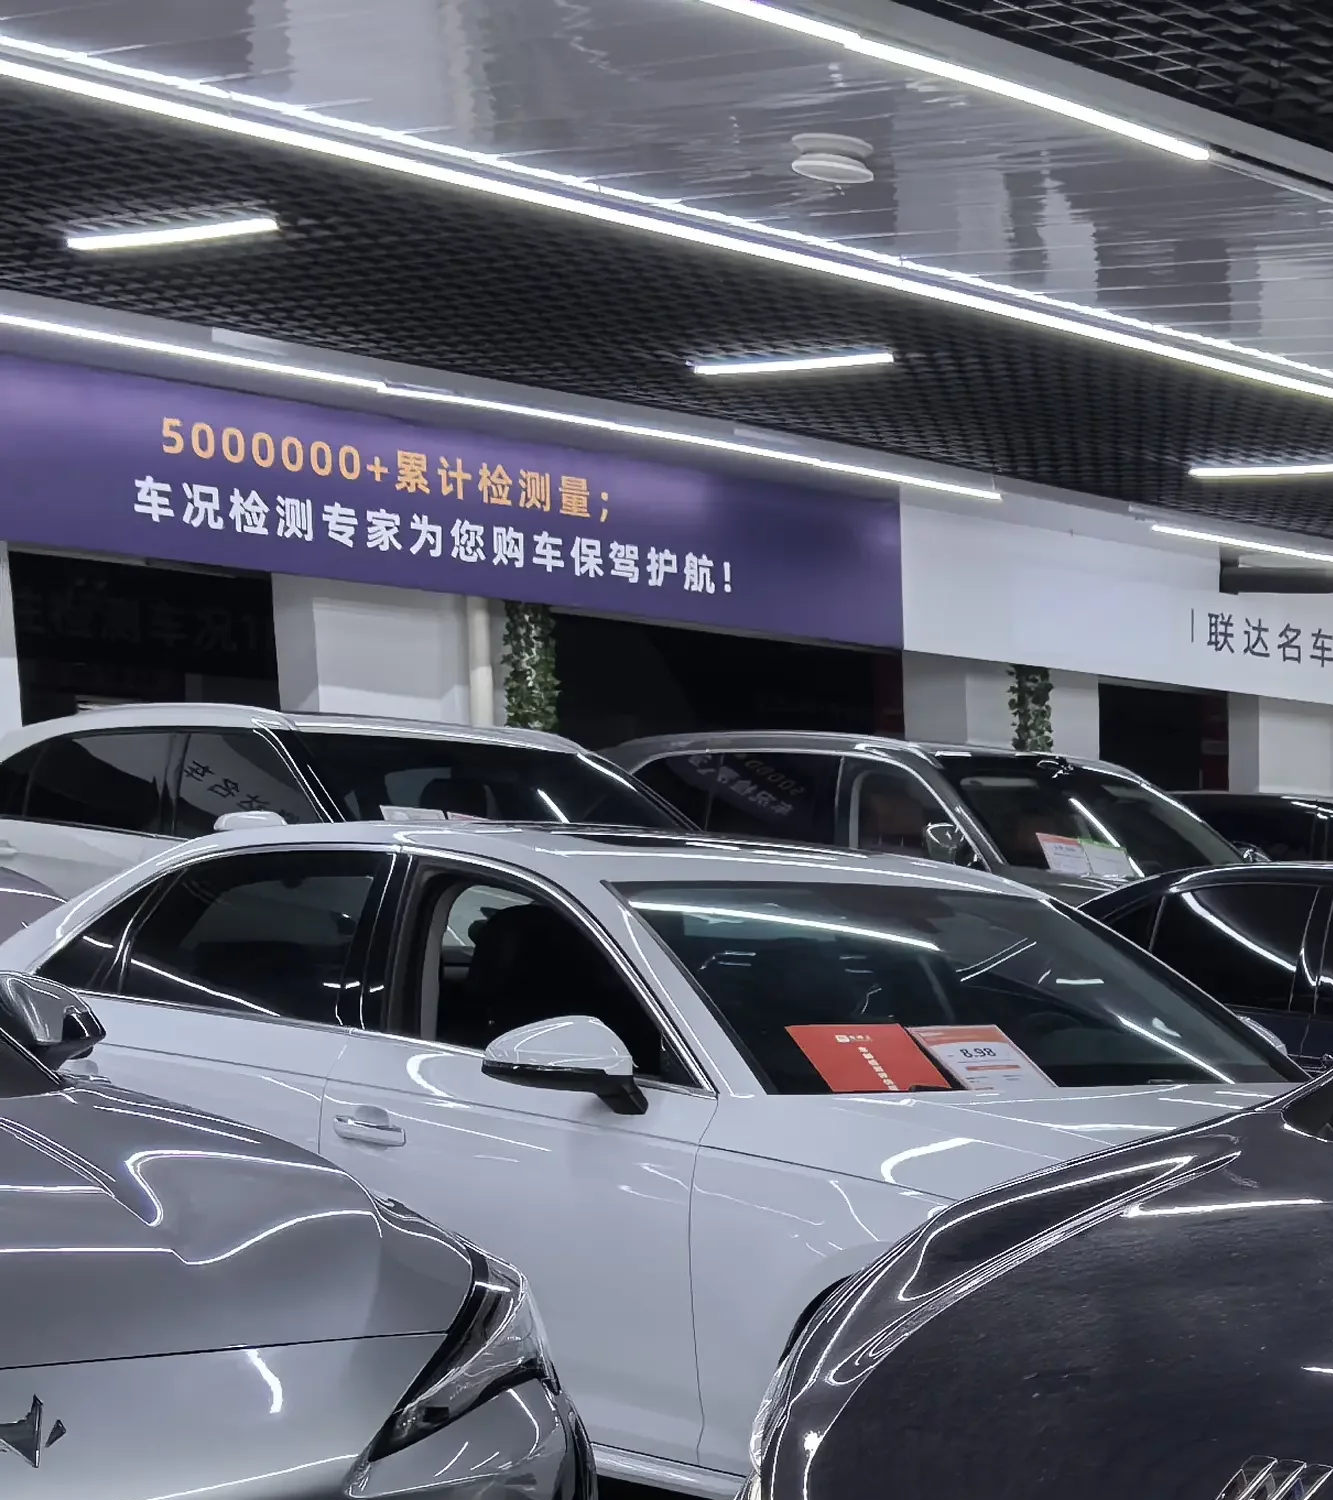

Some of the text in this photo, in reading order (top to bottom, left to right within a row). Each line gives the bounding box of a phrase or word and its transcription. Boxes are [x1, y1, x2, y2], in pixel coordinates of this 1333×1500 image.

[133, 476, 733, 594] 车况检测专家为您购车保驾护航！
[959, 1047, 997, 1059] 8.98
